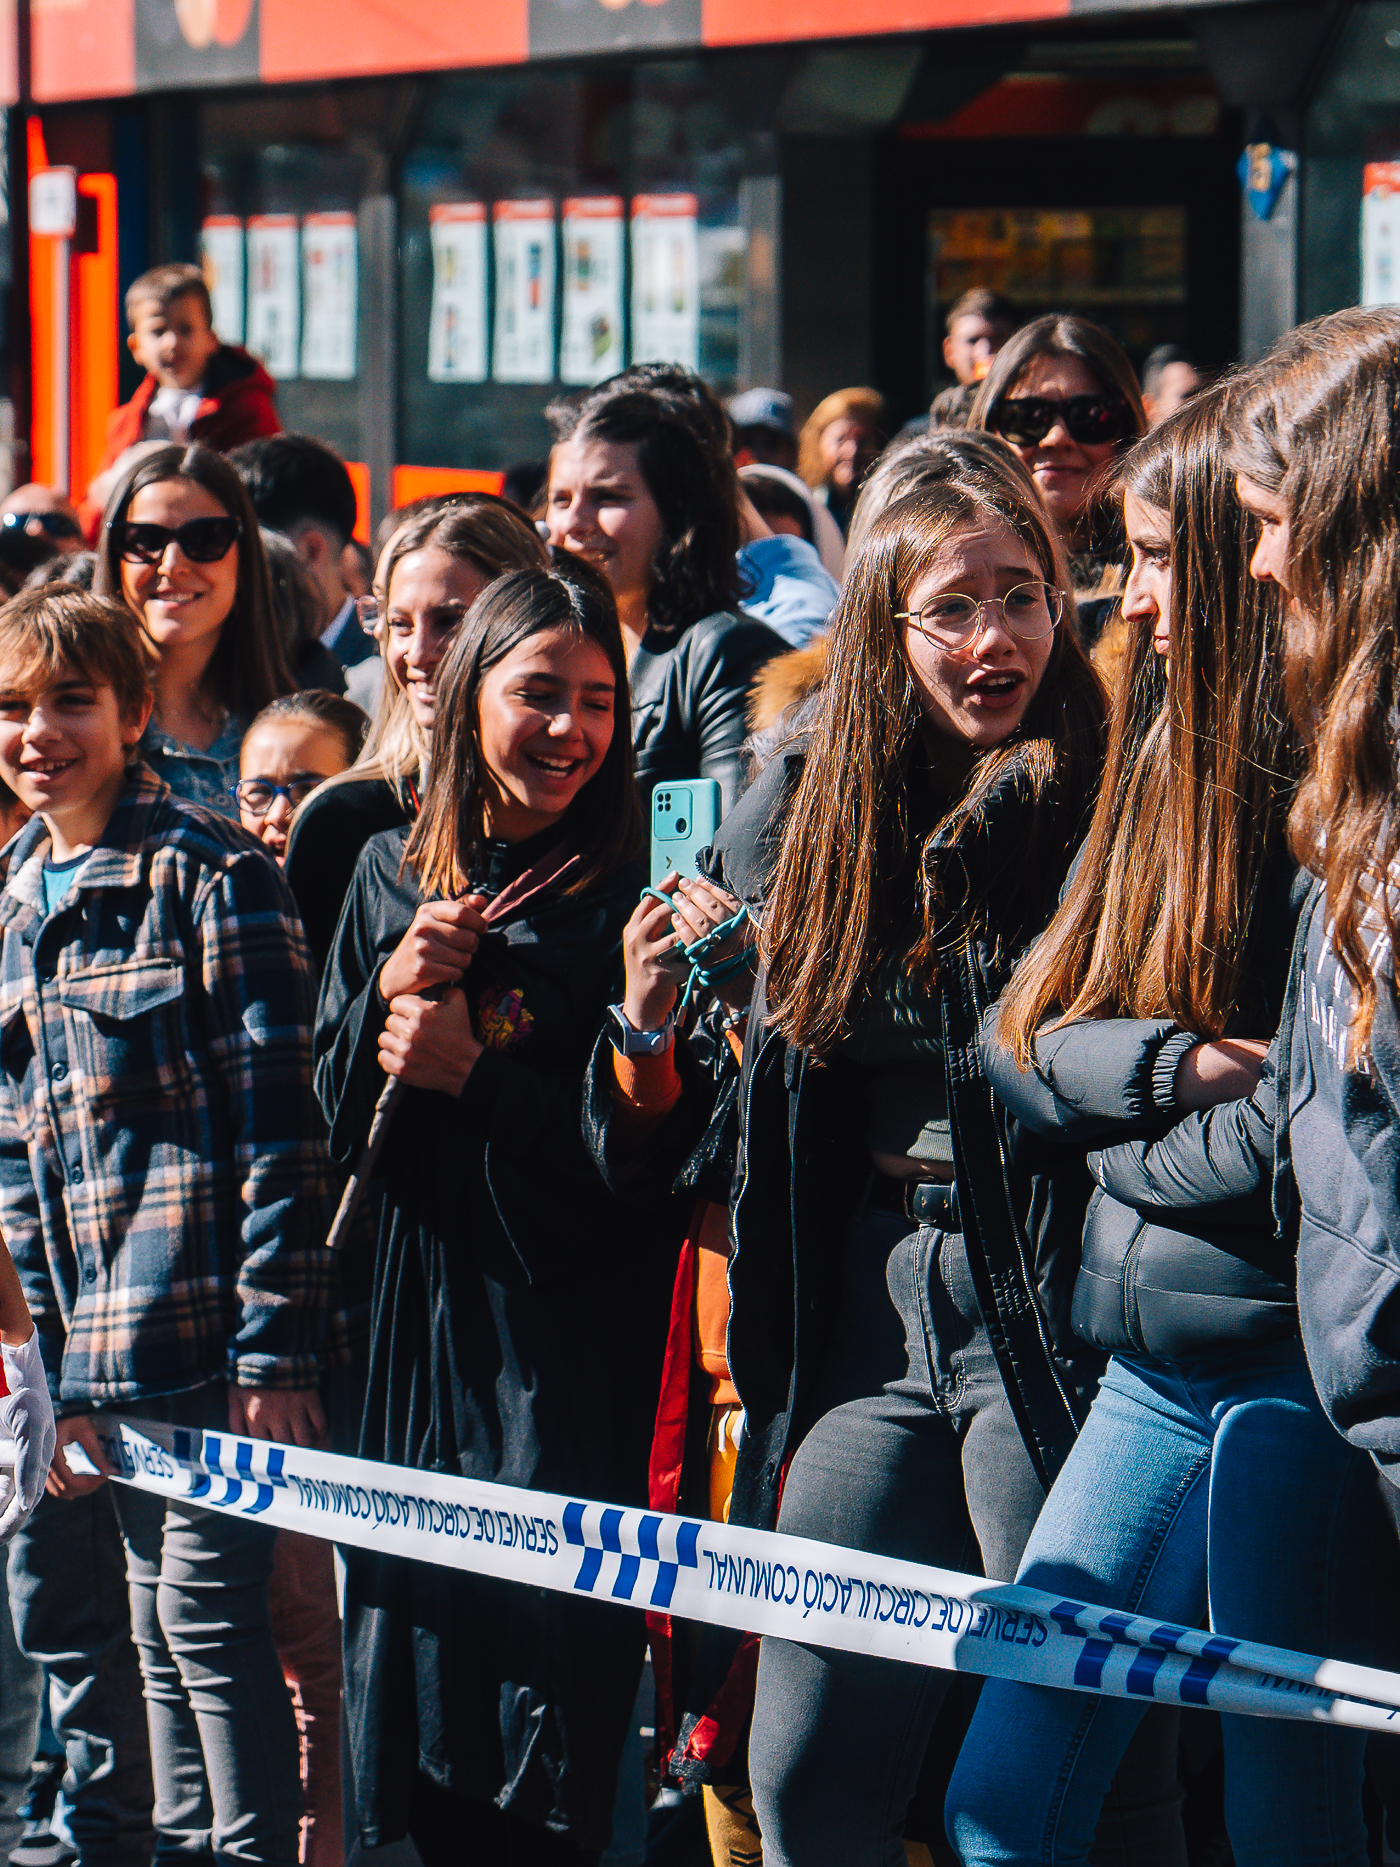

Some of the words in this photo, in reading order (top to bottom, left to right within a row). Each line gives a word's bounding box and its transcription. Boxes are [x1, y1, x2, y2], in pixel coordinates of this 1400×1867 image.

[287, 1473, 372, 1521] COMUNAL
[370, 1488, 471, 1540] CIRCULACIÓ
[469, 1506, 495, 1544] DE
[494, 1510, 559, 1557] SERVEI
[702, 1549, 801, 1606] COMUNAL
[802, 1569, 932, 1629] CIRCULACIÓ
[930, 1593, 967, 1635] DE
[965, 1600, 1049, 1649] SERVEI
